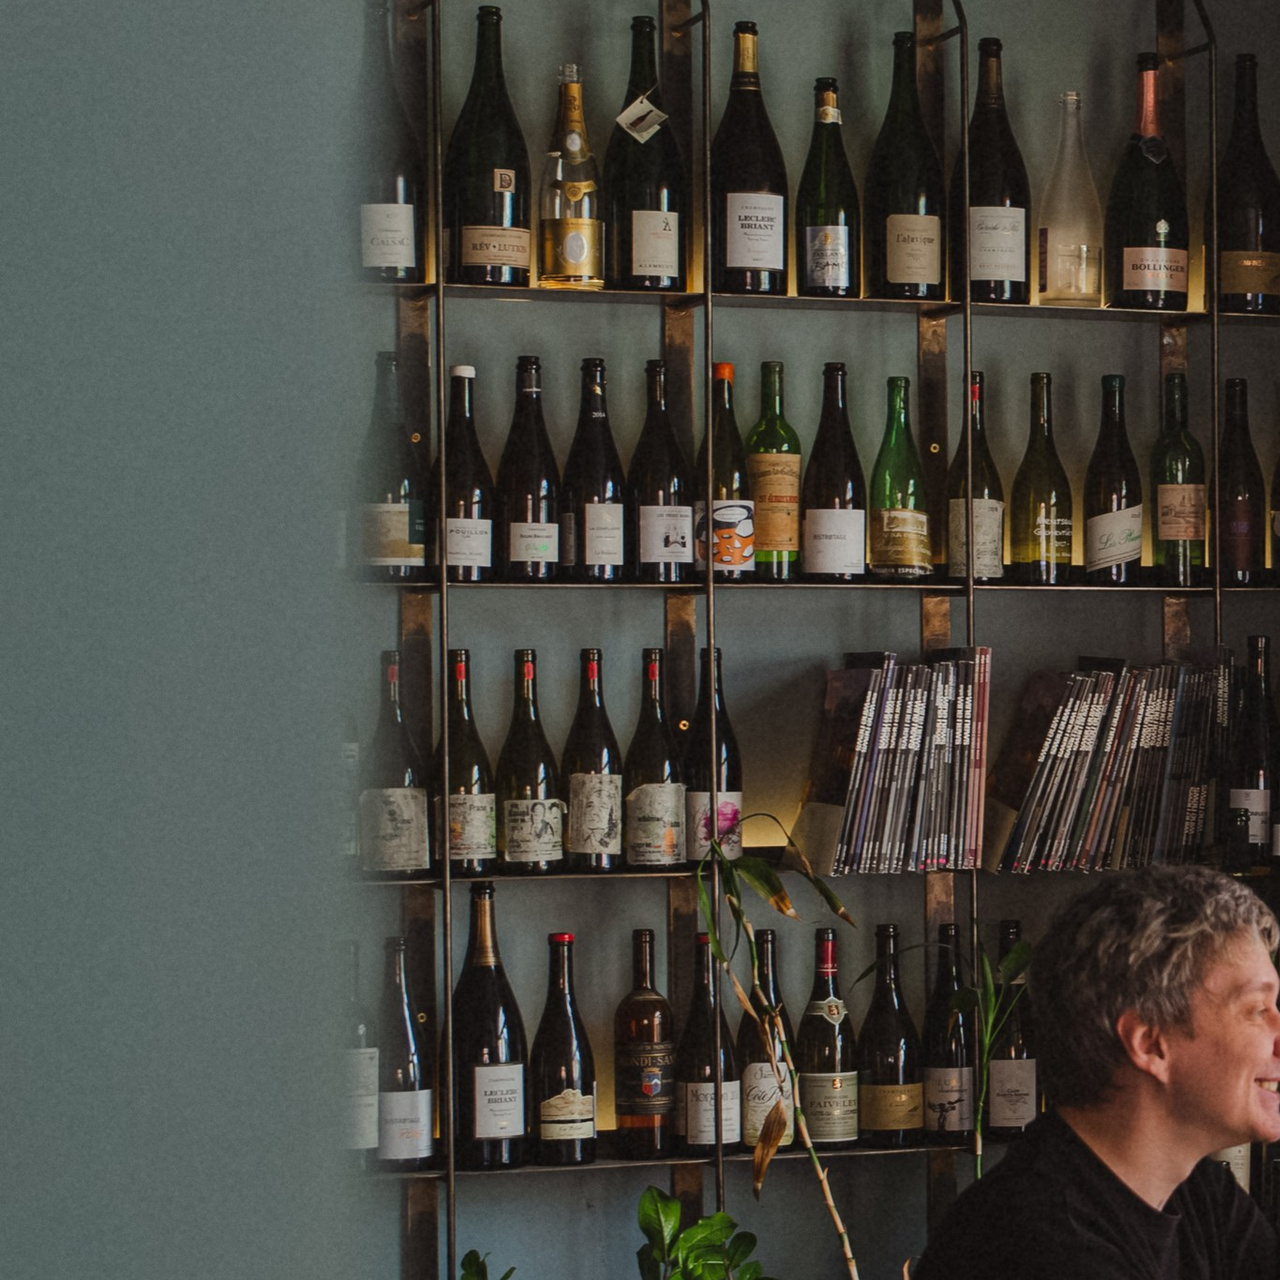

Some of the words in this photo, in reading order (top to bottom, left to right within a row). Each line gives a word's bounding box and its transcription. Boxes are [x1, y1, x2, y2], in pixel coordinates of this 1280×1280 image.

[740, 223, 774, 231] BRIANT
[1131, 263, 1185, 273] BOLLINGER
[487, 1096, 517, 1104] BRIANT
